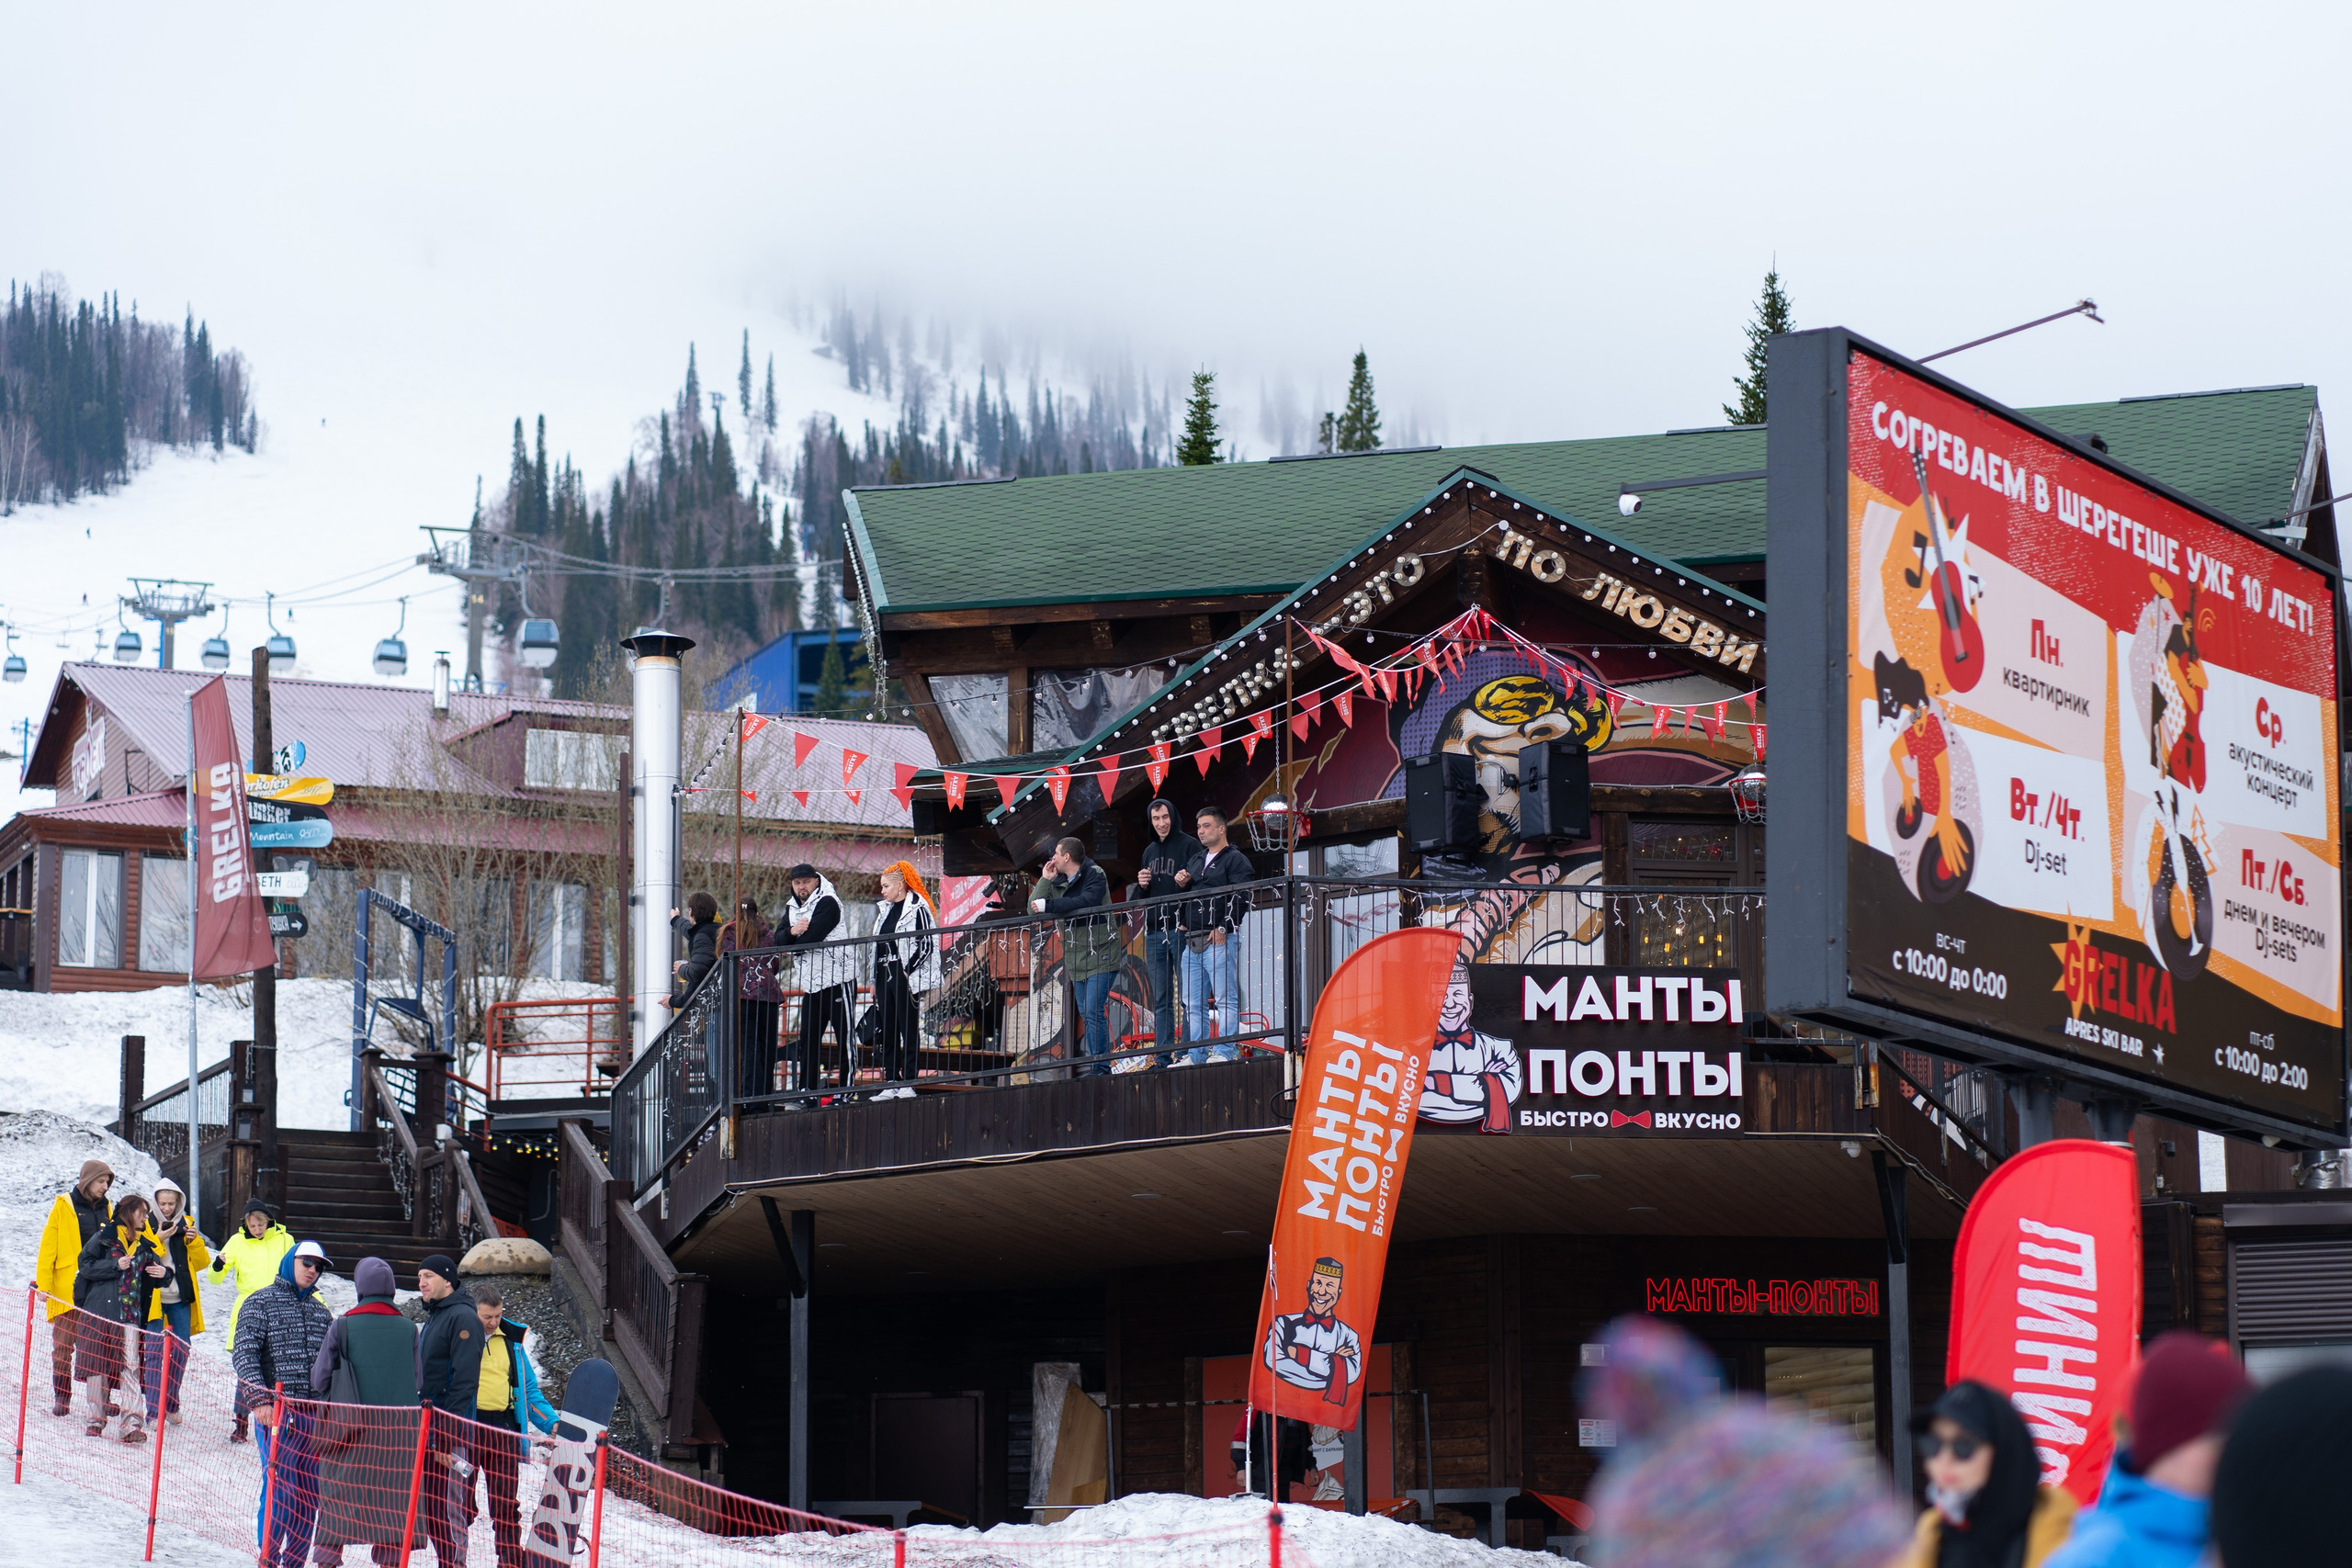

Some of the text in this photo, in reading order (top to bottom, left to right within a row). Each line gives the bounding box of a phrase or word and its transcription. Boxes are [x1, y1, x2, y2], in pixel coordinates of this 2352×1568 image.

[1872, 401, 2313, 636] СОГРЕВАЕМ В ШЕРЕГЕШЕ УЖЕ 10 ЛЕТ!
[1343, 553, 1424, 624] ЭТО
[1496, 529, 1759, 673] ПО ЛЮБВИ
[2030, 618, 2064, 667] Пн.
[2003, 667, 2090, 717] квартирник
[2256, 696, 2287, 749] Ср.
[2229, 742, 2313, 792] акустический
[2247, 773, 2298, 810] концерт
[210, 761, 243, 904] GRELKA
[247, 802, 291, 823] unker
[1148, 856, 1174, 876] POLO
[2025, 839, 2067, 875] Dj-set
[2224, 898, 2325, 949] днем и вечером
[2256, 928, 2297, 963] Dj-sets
[1905, 948, 1947, 982] 10:00
[1949, 966, 1969, 991] до
[1973, 967, 2007, 999] 0:00
[2063, 939, 2177, 1034] GRELKA
[1522, 976, 1743, 1024] МАНТЫ
[2064, 1017, 2143, 1057] APRES SKI BAR
[1527, 1049, 1743, 1097] ПОНТЫ
[2224, 1045, 2259, 1076] 10:00
[2261, 1062, 2278, 1084] до
[2280, 1062, 2308, 1090] 2:00
[1297, 1030, 1367, 1220] МАНТЫ
[1335, 1041, 1404, 1232] ПОНТЫ
[1520, 1110, 1741, 1130] БЫСТРО ВКУСНО
[1372, 1055, 1419, 1237] БЫСТРО ВКУСНО
[1646, 1278, 1879, 1315] МАНТЫ-ПОНТЫ
